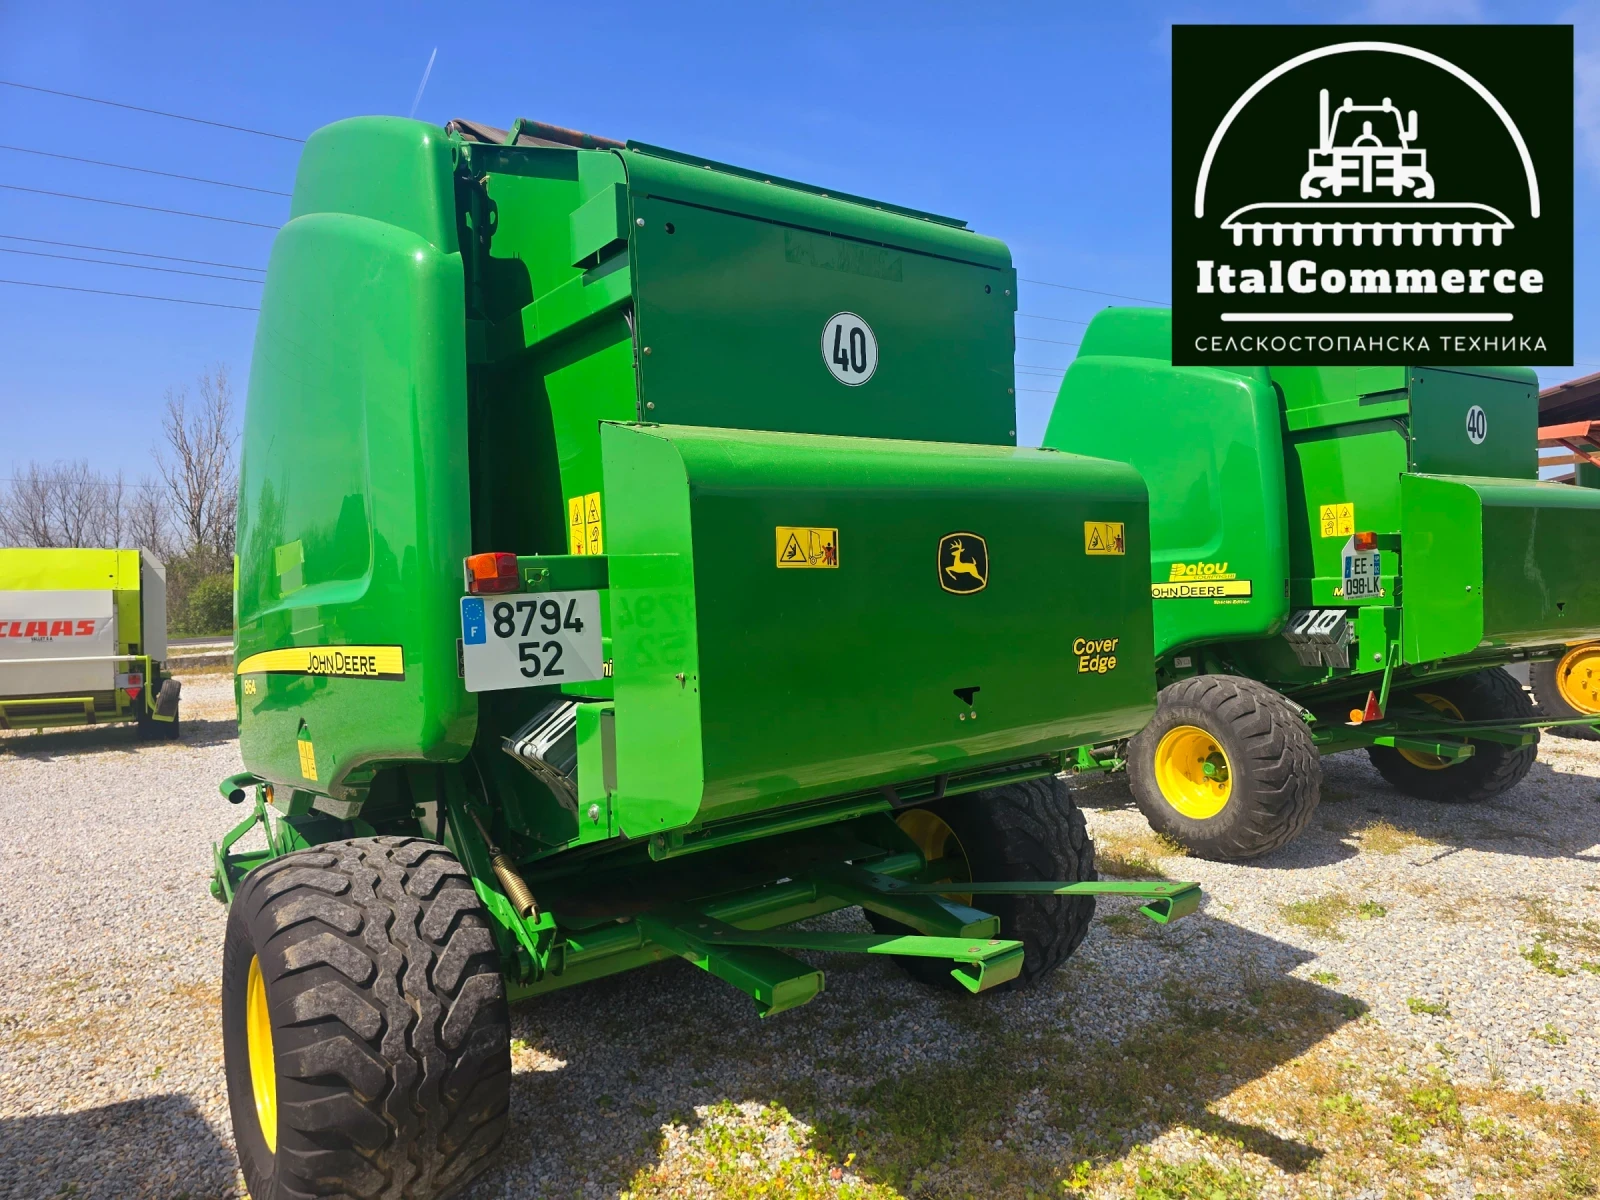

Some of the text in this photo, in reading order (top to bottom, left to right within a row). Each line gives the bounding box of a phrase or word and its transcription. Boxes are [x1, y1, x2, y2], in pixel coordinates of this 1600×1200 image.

[833, 324, 867, 374] 40
[1467, 408, 1485, 440] 40
[1152, 585, 1225, 597] OHN DEERE
[492, 598, 584, 639] 8794
[470, 626, 478, 637] F
[1073, 637, 1119, 655] Cover
[307, 651, 377, 673] JOHN DEERE
[518, 640, 565, 678] 52
[1078, 654, 1117, 674] Edge
